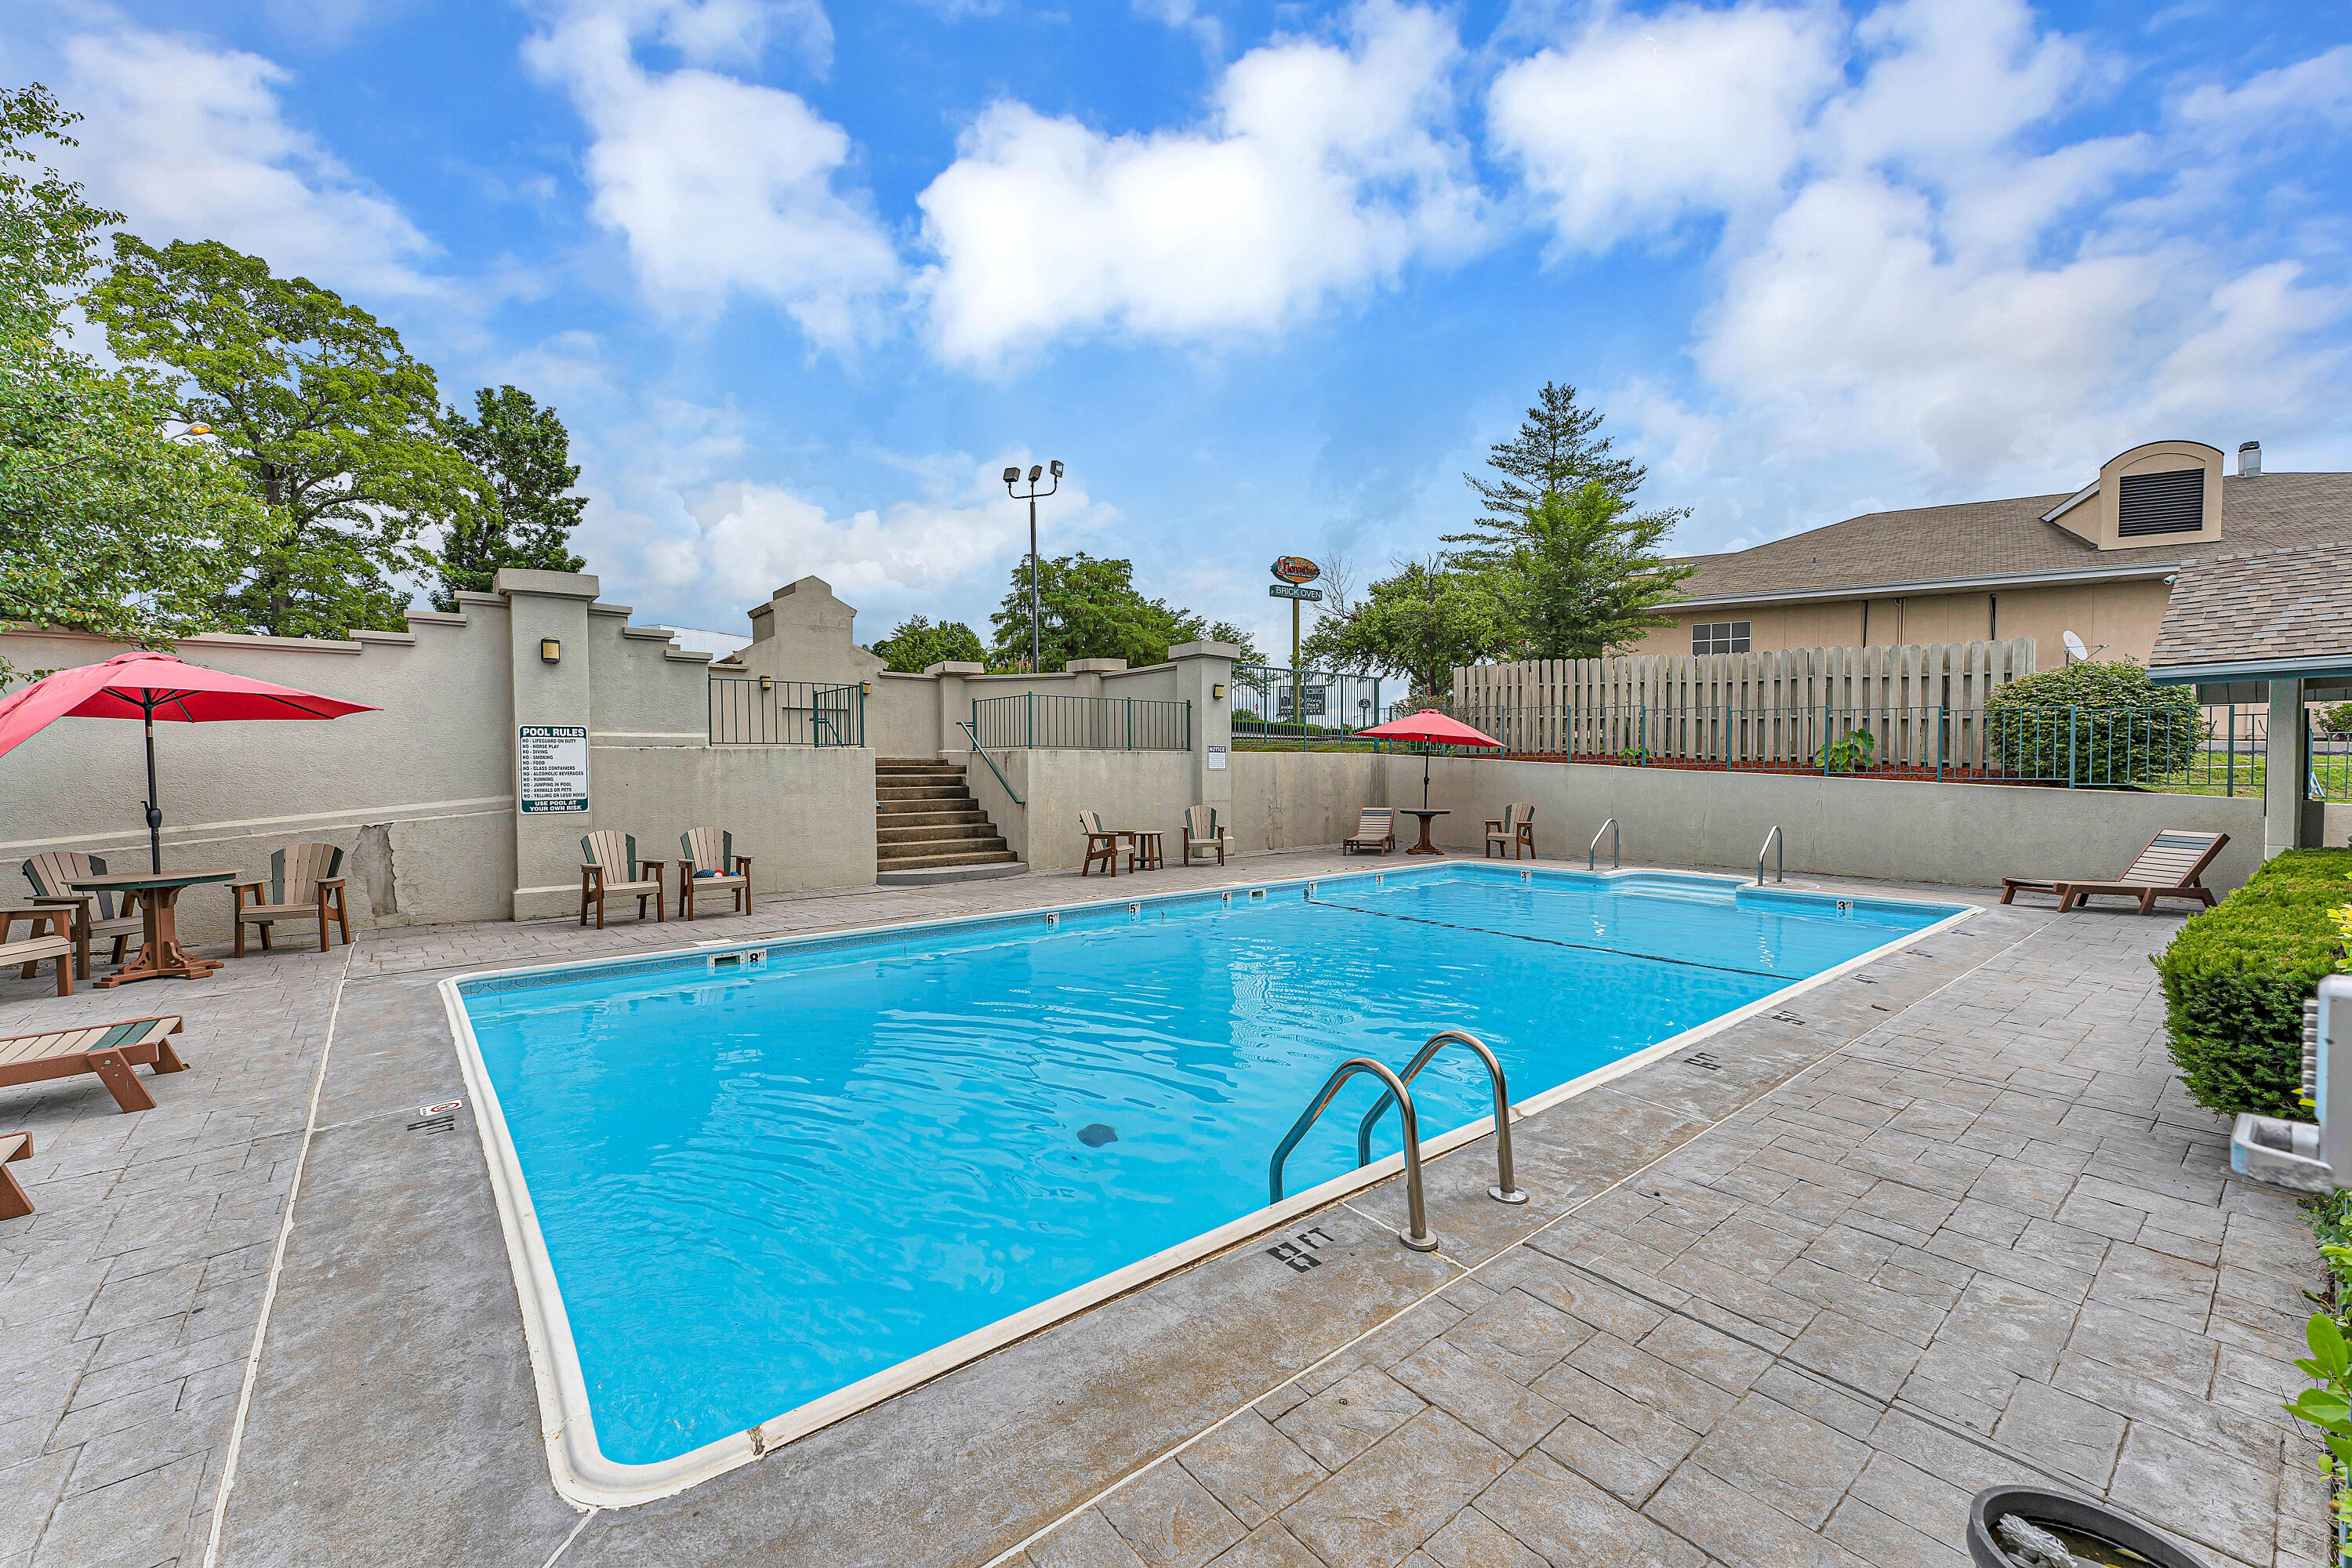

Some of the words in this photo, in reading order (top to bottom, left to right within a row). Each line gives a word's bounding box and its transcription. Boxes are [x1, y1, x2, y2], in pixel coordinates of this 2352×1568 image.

[1276, 586, 1299, 596] BRICK
[1301, 590, 1321, 599] OVEN
[523, 728, 550, 736] POOL
[553, 728, 584, 737] RULES
[1131, 904, 1136, 913] 5
[1838, 901, 1846, 909] 3
[1047, 914, 1054, 924] 6
[750, 953, 758, 962] 8
[1296, 1227, 1334, 1250] FT
